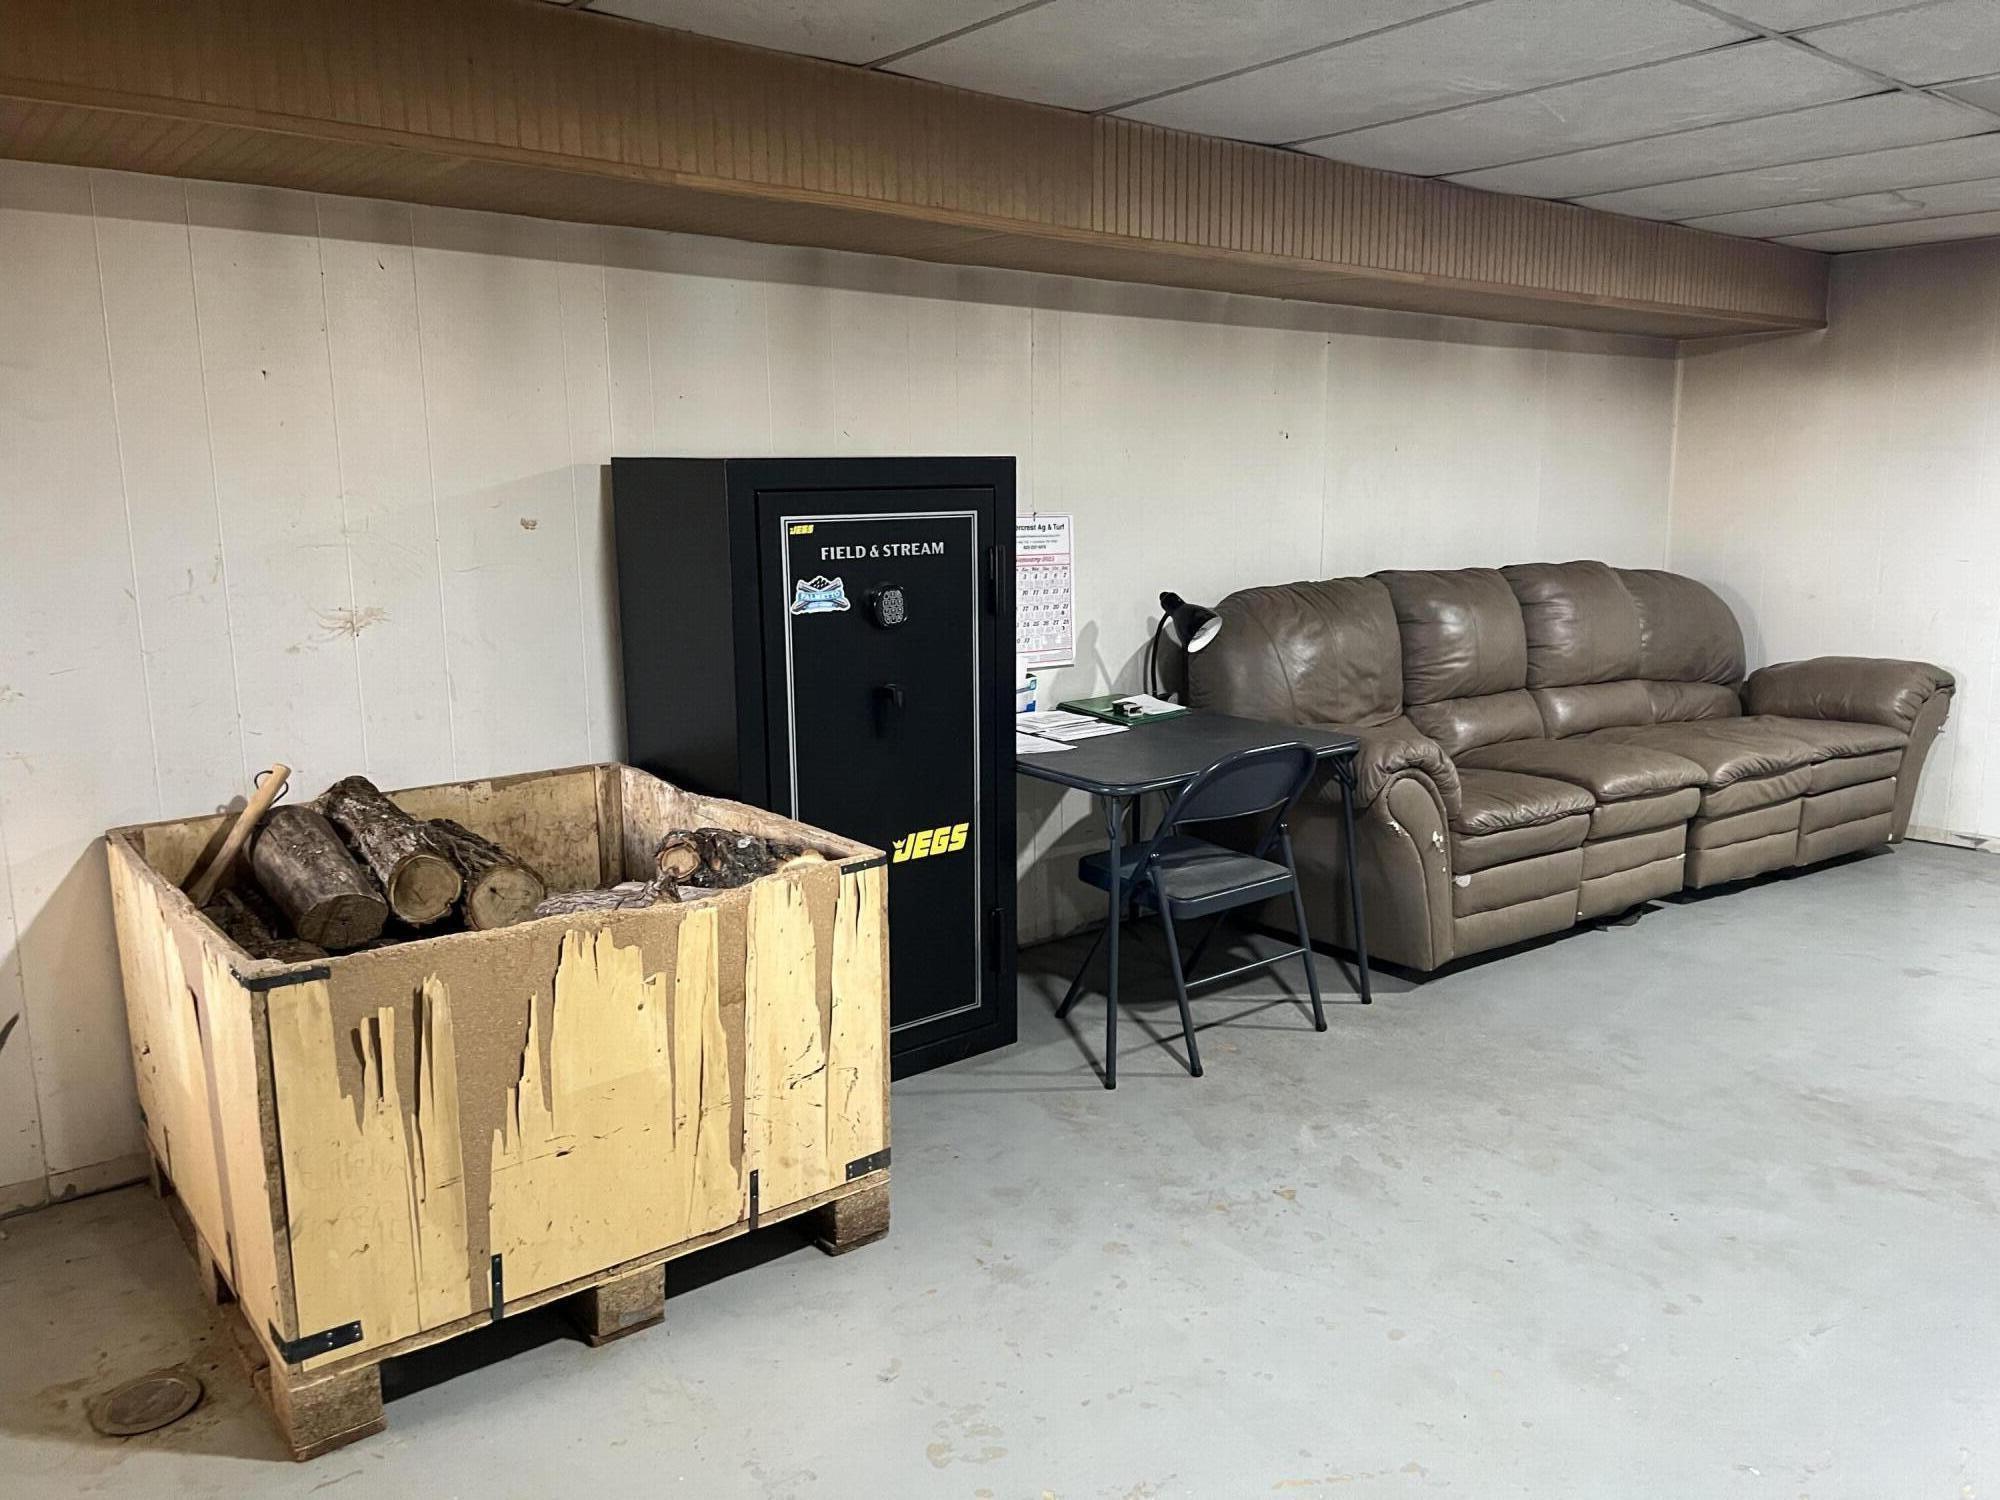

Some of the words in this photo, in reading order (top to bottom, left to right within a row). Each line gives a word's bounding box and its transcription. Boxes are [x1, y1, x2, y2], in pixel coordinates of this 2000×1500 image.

[1037, 524, 1046, 532] Ag
[821, 546, 866, 560] FIELD
[870, 544, 879, 558] &
[883, 542, 944, 557] STREAM
[892, 822, 969, 863] JEGS
